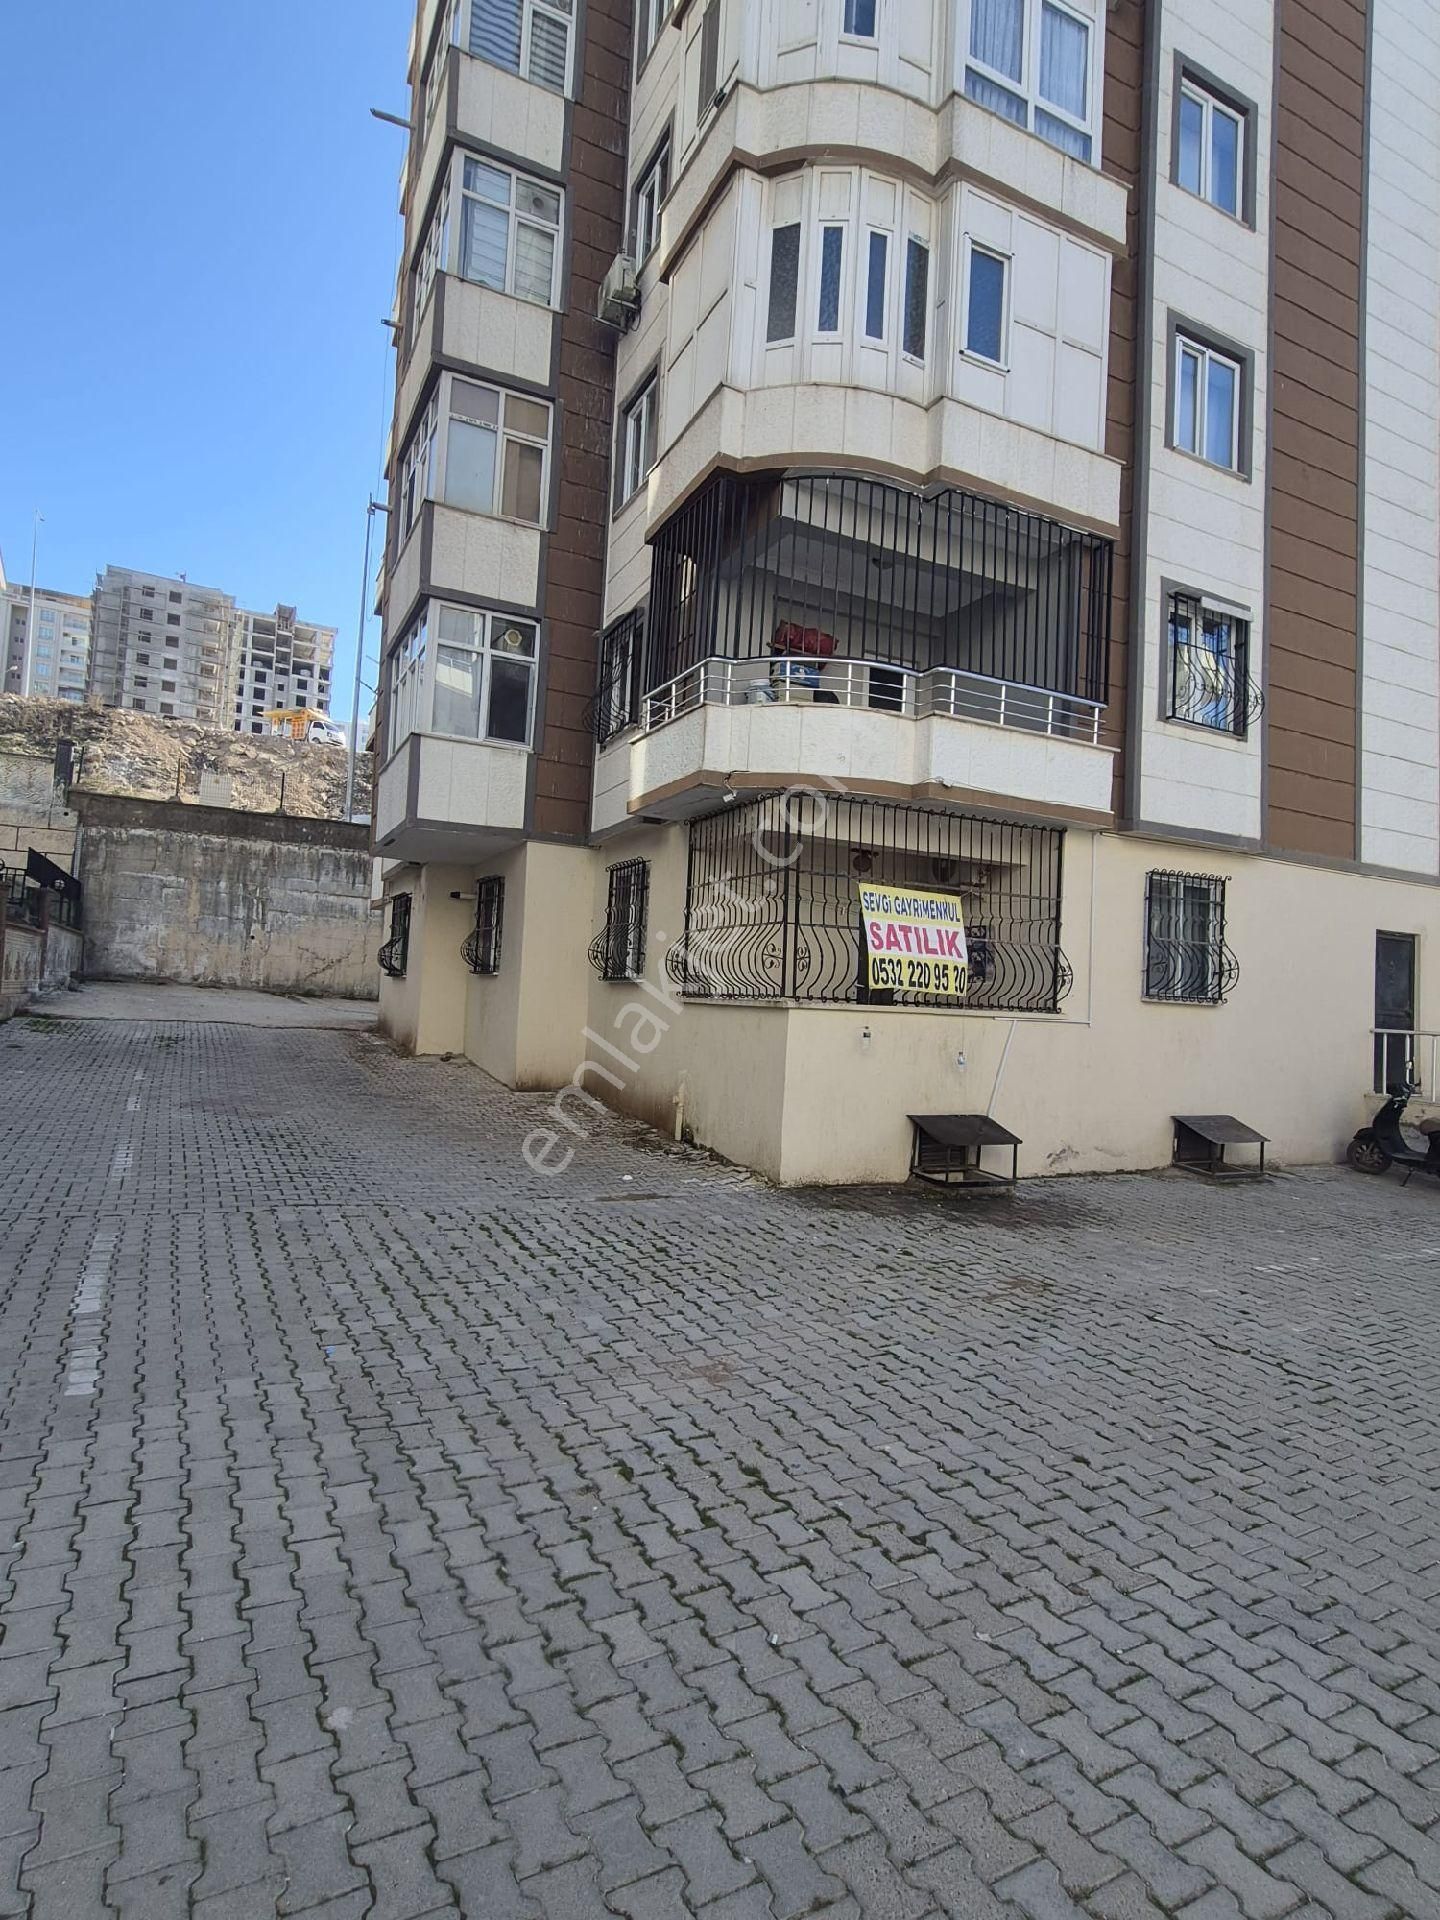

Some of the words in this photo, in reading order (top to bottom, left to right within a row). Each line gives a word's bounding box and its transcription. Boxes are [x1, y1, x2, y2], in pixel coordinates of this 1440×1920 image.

[869, 922, 963, 959] SATILIK
[872, 958, 904, 987] 0532
[908, 960, 931, 989] 220
[934, 964, 949, 991] 95
